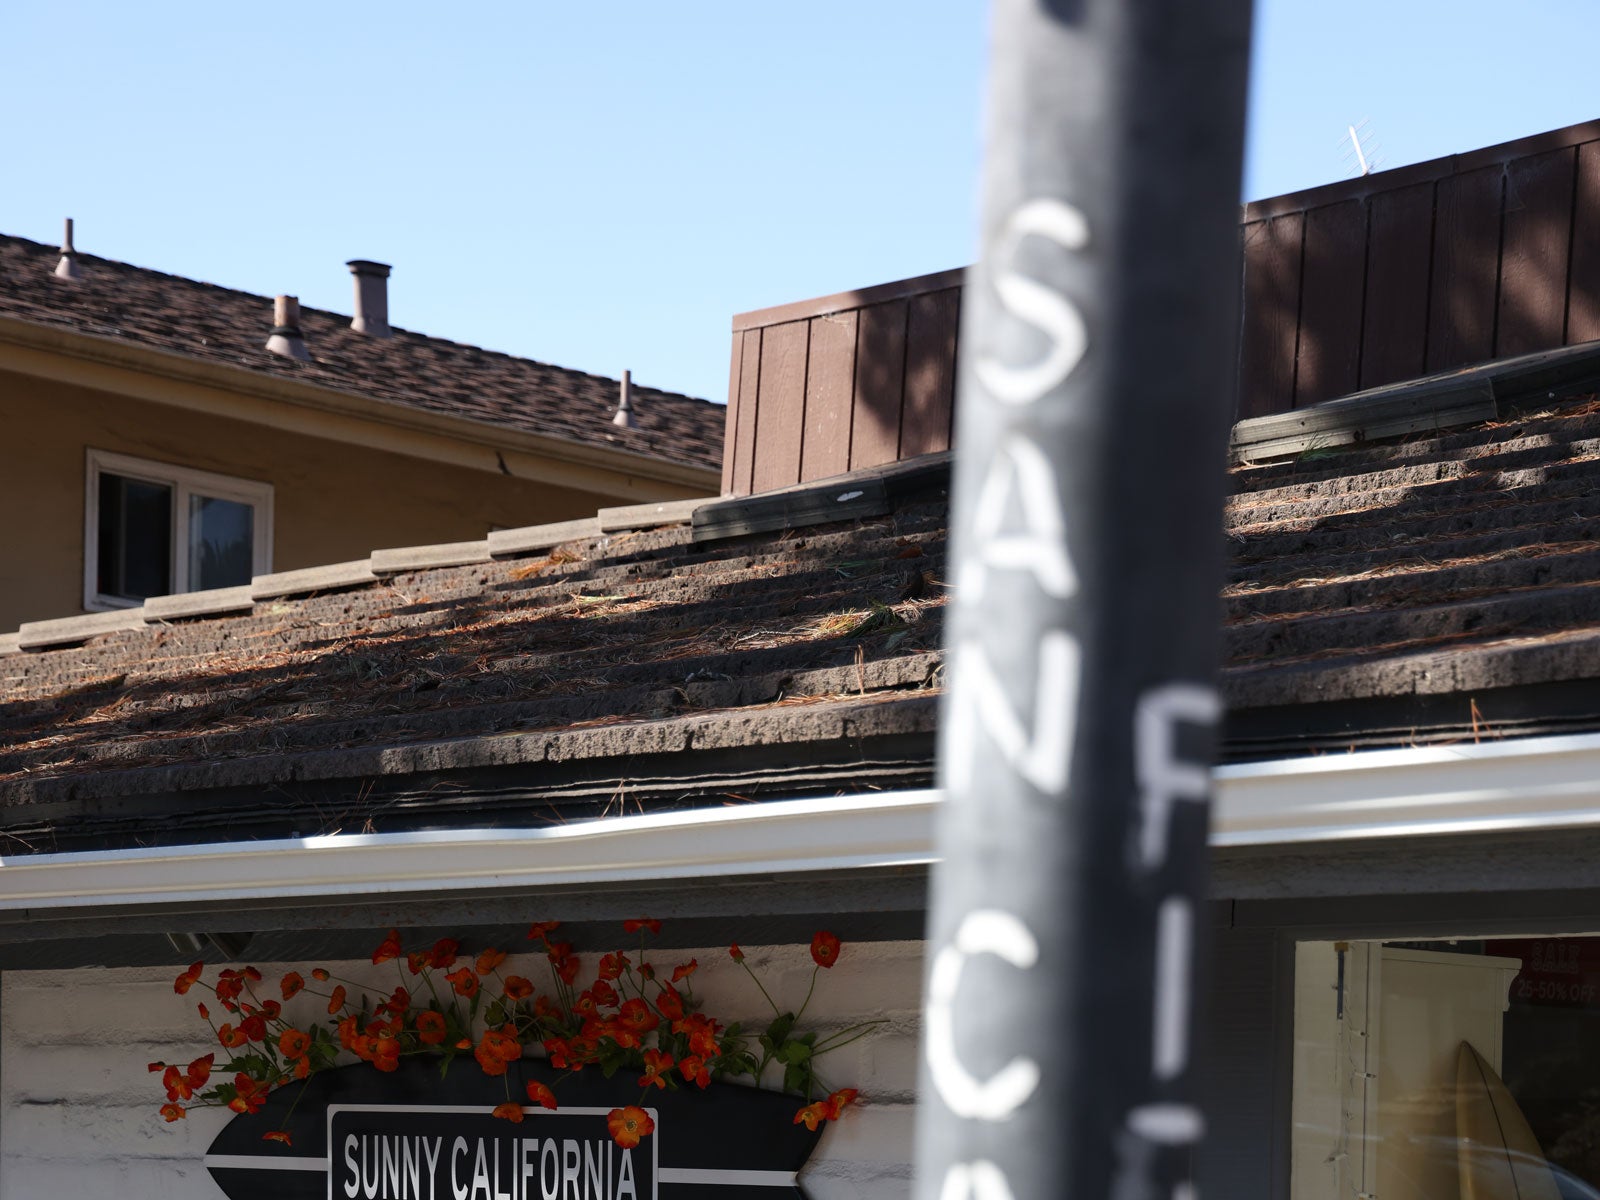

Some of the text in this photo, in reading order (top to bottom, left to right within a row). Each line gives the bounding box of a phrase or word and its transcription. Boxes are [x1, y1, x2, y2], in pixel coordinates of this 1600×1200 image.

[940, 197, 1092, 797] SAN
[1530, 942, 1582, 974] SALE
[1517, 978, 1597, 1003] 25-50% OFF
